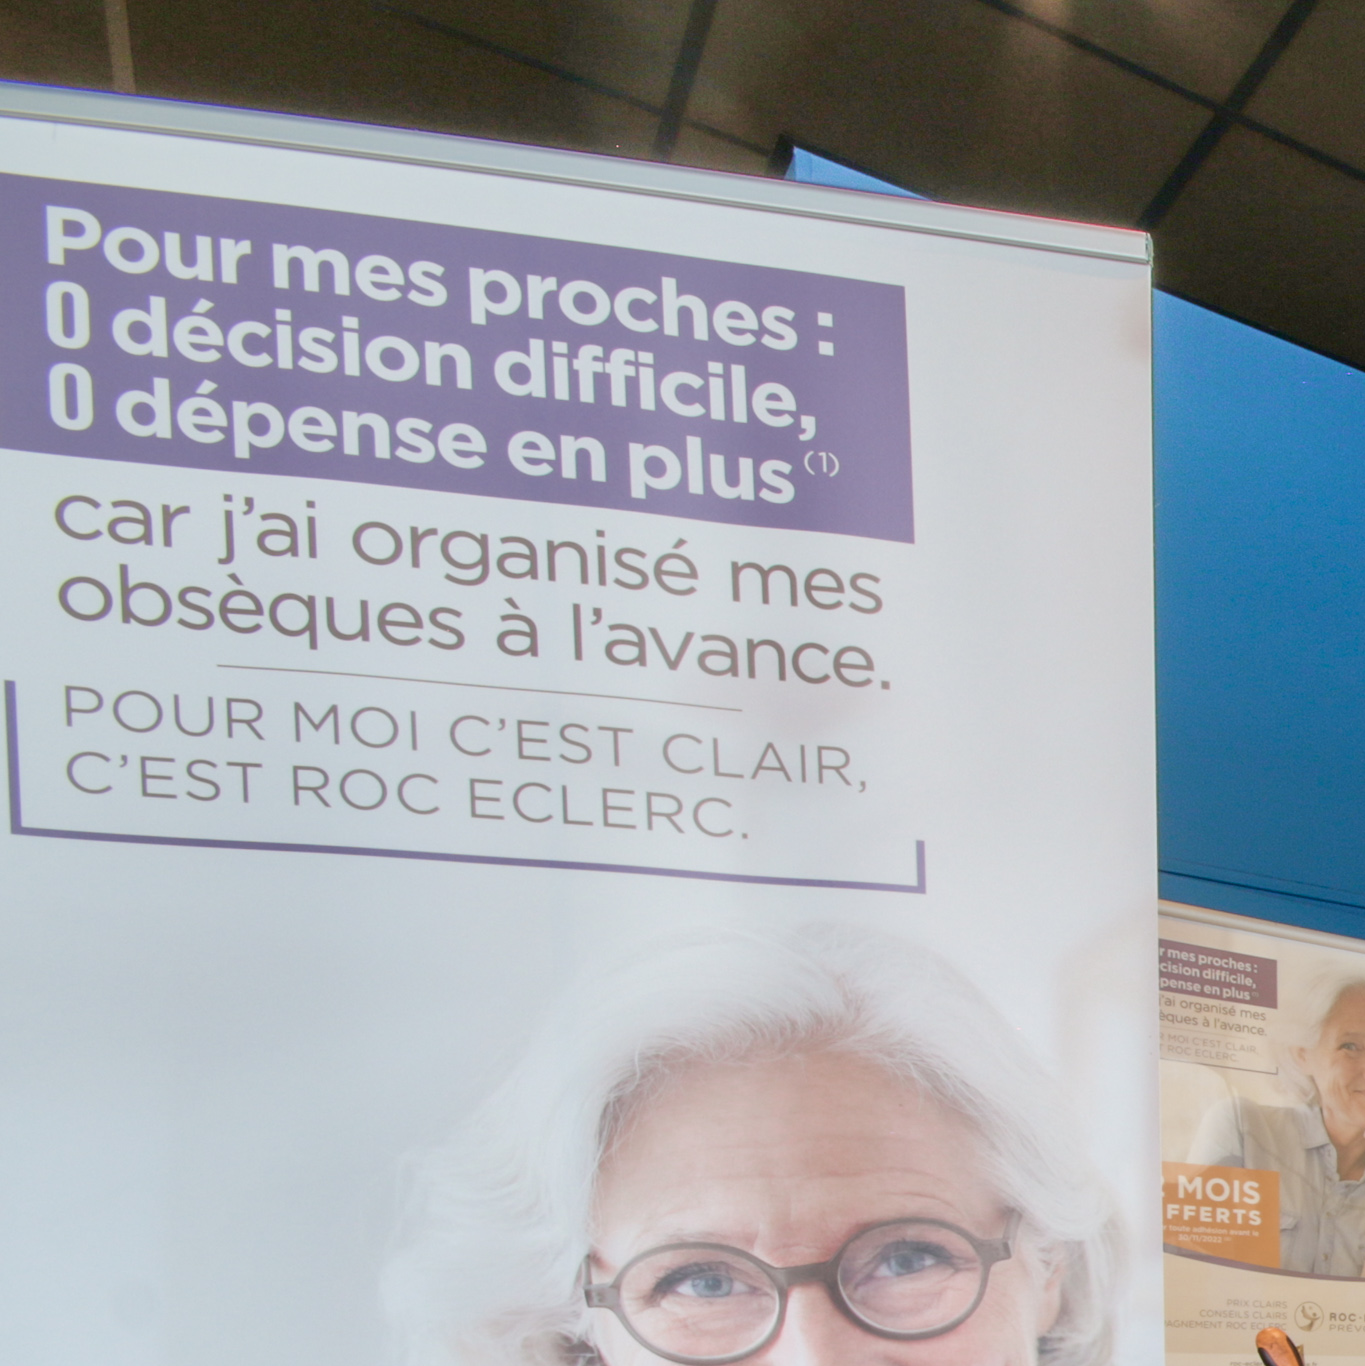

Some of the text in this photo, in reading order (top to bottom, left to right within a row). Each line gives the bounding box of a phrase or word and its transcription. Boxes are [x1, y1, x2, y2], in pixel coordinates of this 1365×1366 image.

[47, 206, 251, 284] Pour
[273, 244, 447, 306] mes
[469, 267, 797, 350] proches
[46, 281, 815, 440] 0 décision difficile,
[49, 363, 93, 430] 0
[116, 377, 487, 469] dépense
[508, 431, 606, 482] en
[55, 494, 882, 614] car j'ai organisé mes
[59, 564, 889, 689] obsèques à l'avance.
[65, 686, 865, 792] POUR MOI C'EST CLAIR,
[67, 752, 748, 839] C'EST ROC ECLERC.
[1168, 949, 1251, 972] mes proches
[1160, 962, 1256, 989] cision difficile,
[1160, 977, 1201, 992] pense
[1204, 985, 1220, 995] en
[1180, 1000, 1266, 1021] organisé mes
[1214, 1018, 1267, 1036] l'avance.
[1178, 1175, 1260, 1205] MOIS
[1167, 1204, 1261, 1225] FFERTS
[1200, 1309, 1287, 1320] CONSEILS CLAIRS
[1227, 1299, 1287, 1309] PRIX CLAIRS
[1165, 1320, 1223, 1329] AGNEMENT
[1226, 1321, 1247, 1330] ROC
